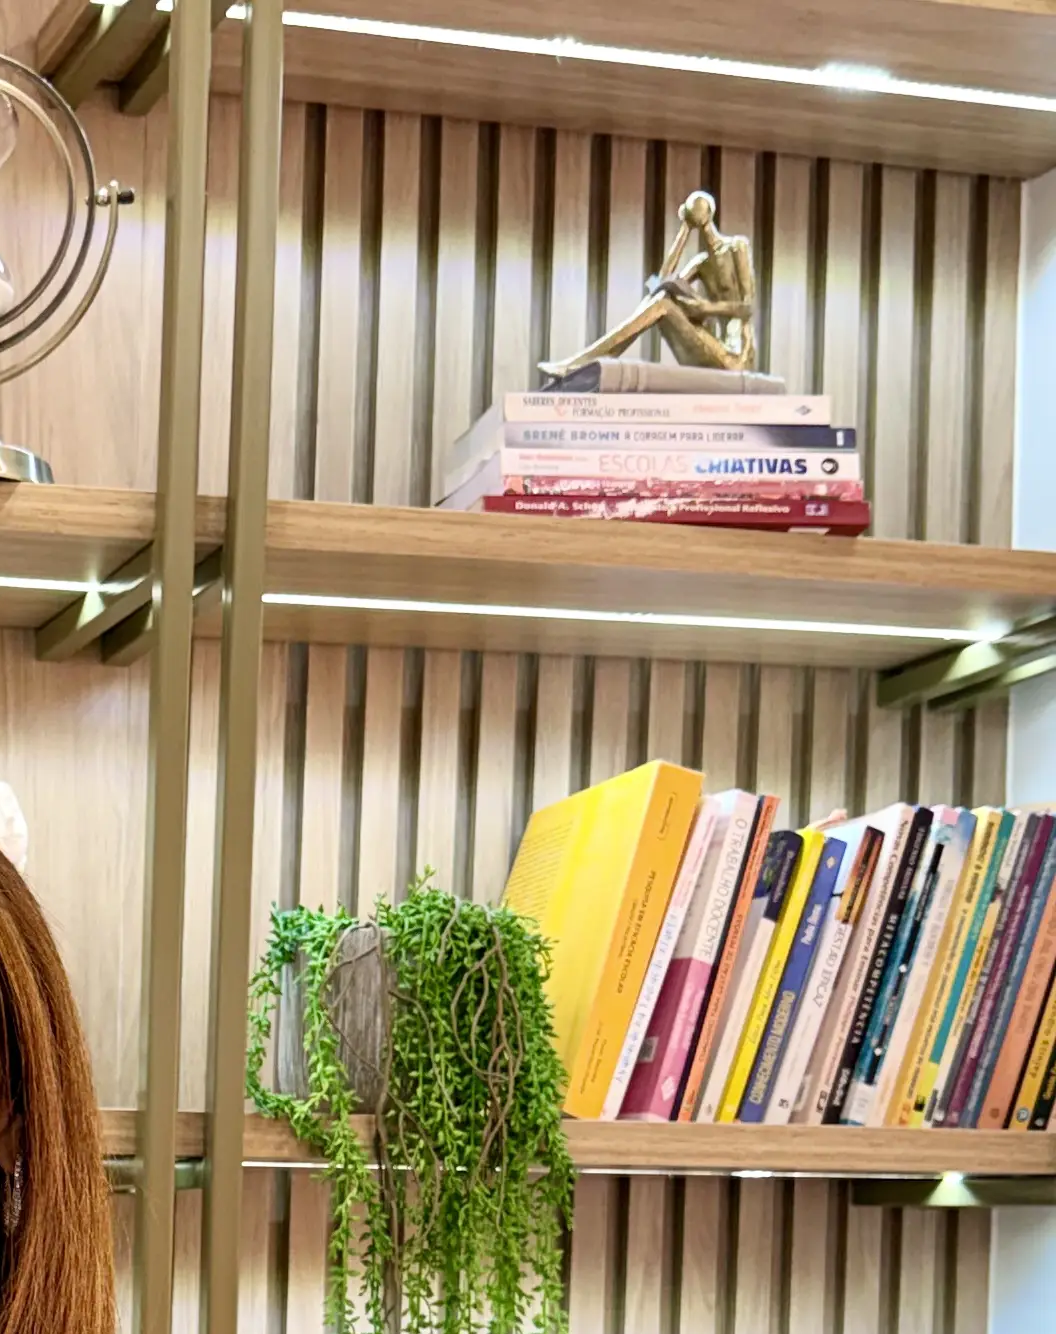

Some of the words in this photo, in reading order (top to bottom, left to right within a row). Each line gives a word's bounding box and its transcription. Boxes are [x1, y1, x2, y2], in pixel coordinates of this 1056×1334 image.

[523, 429, 566, 442] BRENÉ
[571, 430, 620, 443] BROWN
[633, 431, 677, 443] CORAGEM
[679, 431, 704, 443] PARA
[599, 454, 688, 473] ESCOLAS
[696, 457, 808, 475] CRIATIVAS
[515, 501, 555, 510] Donald
[718, 832, 744, 897] TRABALHO
[702, 899, 725, 958] DOCENTE
